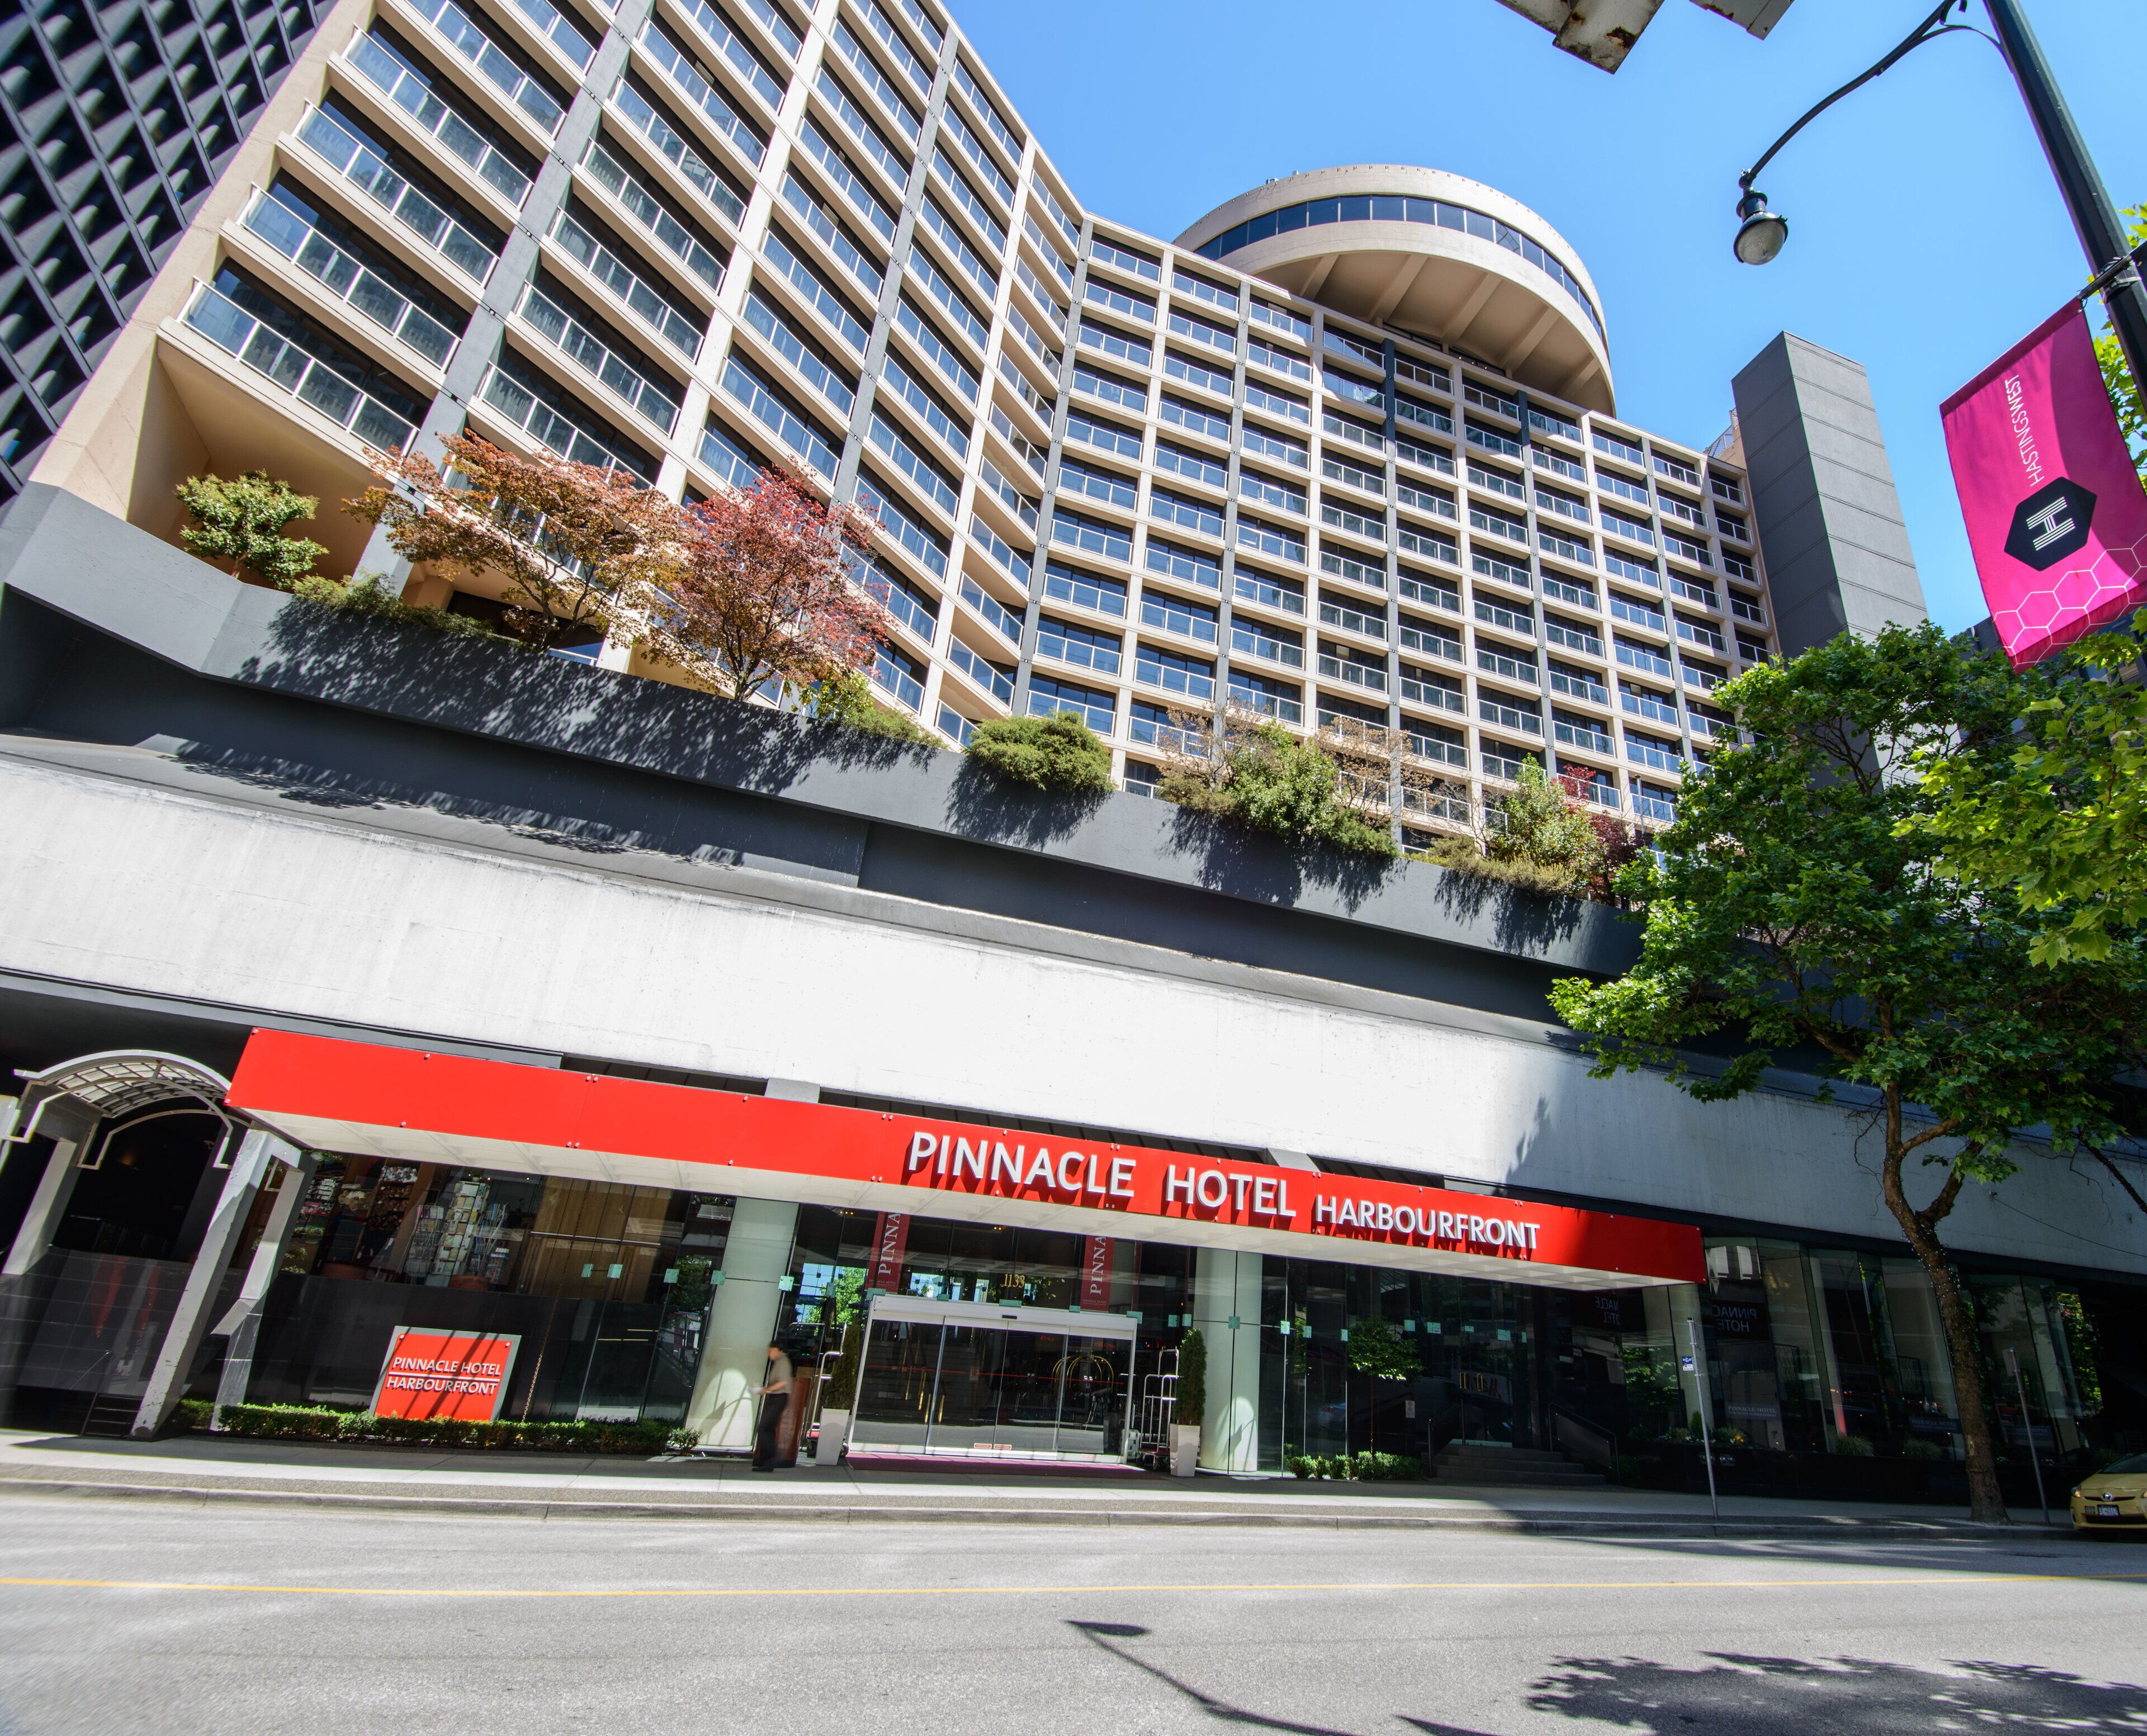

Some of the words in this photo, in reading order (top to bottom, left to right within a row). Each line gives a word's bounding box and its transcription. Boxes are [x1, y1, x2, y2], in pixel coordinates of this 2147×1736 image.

[2004, 374, 2045, 486] HASTINGSWEST
[909, 1131, 1136, 1196] PINNACLE
[1166, 1164, 1297, 1217] HOTEL
[1316, 1194, 1540, 1249] HARBOURFRONT
[1003, 1274, 1025, 1288] 1133
[392, 1357, 459, 1373] PINNACLE
[461, 1361, 501, 1375] HOTEL
[386, 1376, 498, 1394] HARBOURFRONT
